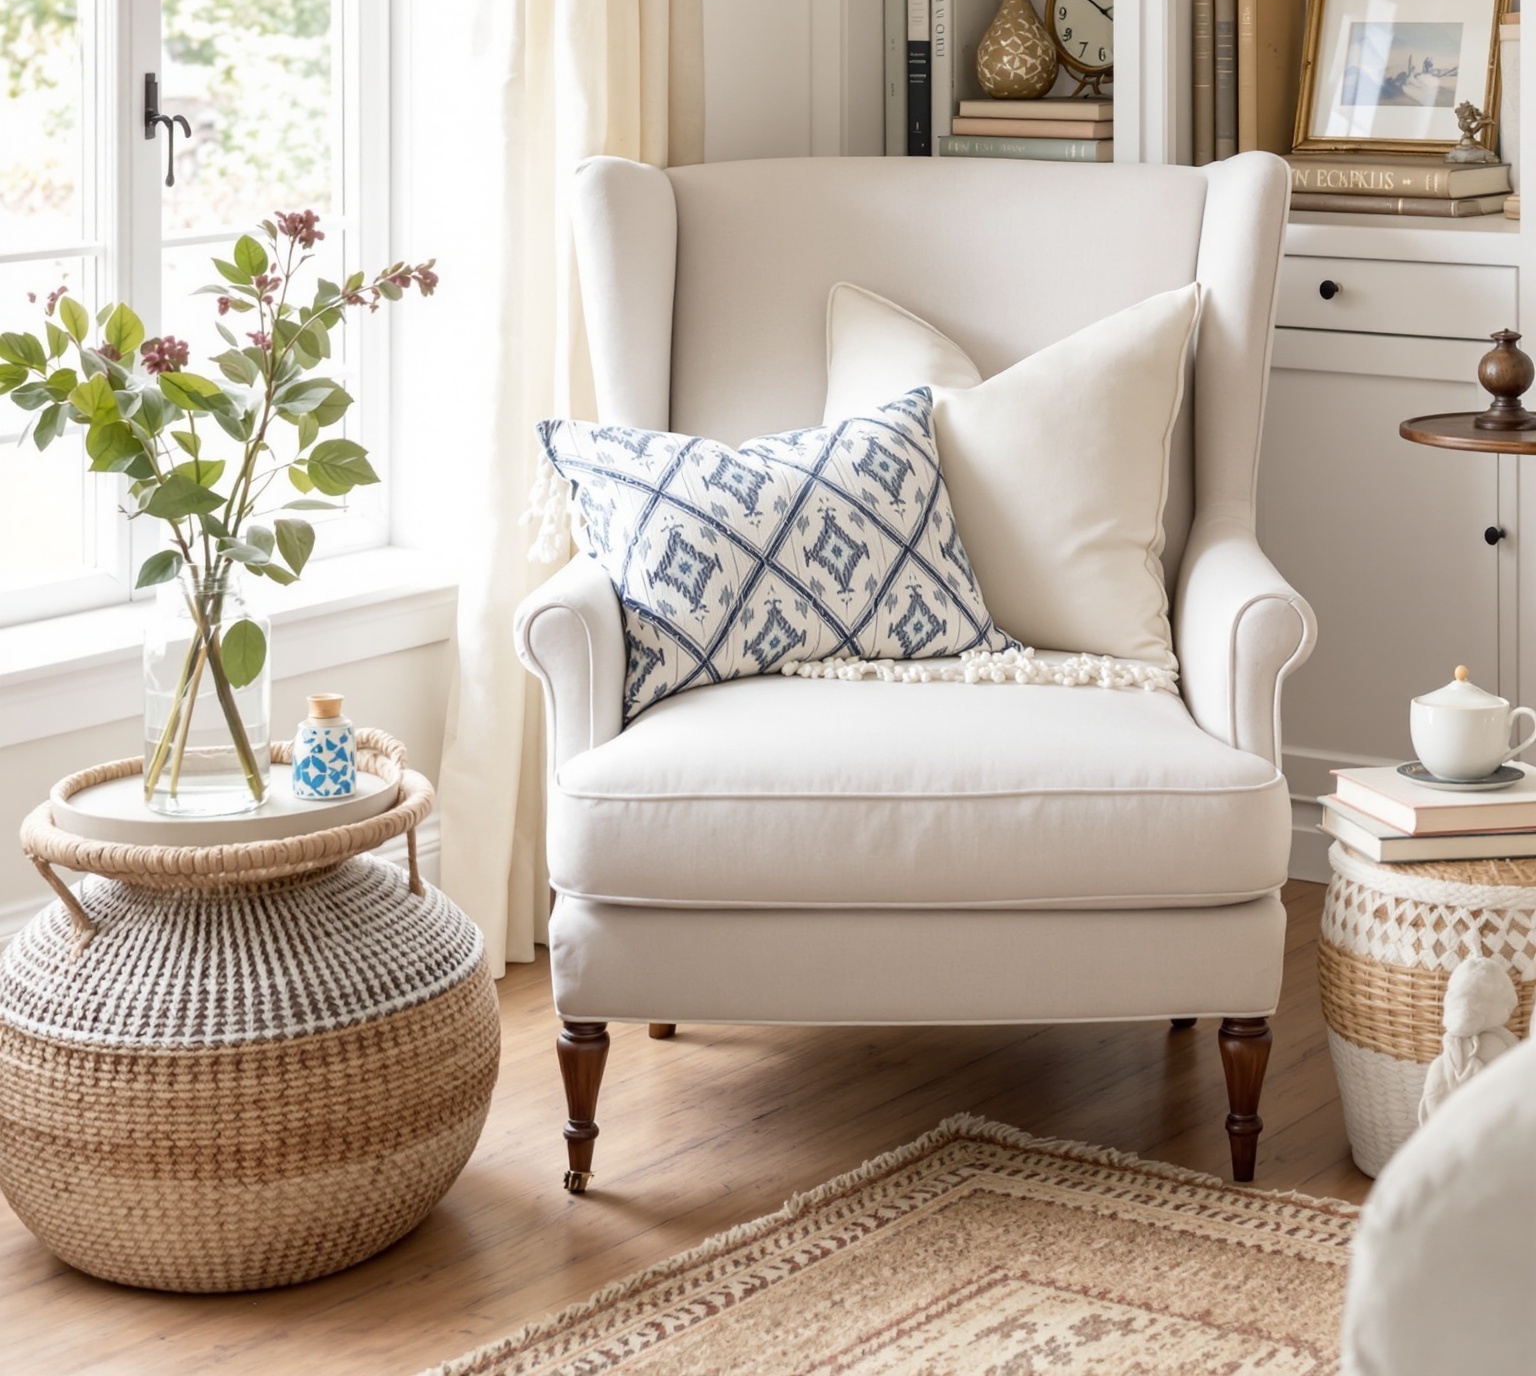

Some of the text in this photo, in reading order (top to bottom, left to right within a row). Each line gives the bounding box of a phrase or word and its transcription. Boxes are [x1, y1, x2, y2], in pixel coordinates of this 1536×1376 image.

[1058, 6, 1068, 21] 9
[1078, 41, 1089, 59] 7
[1098, 46, 1106, 63] 6
